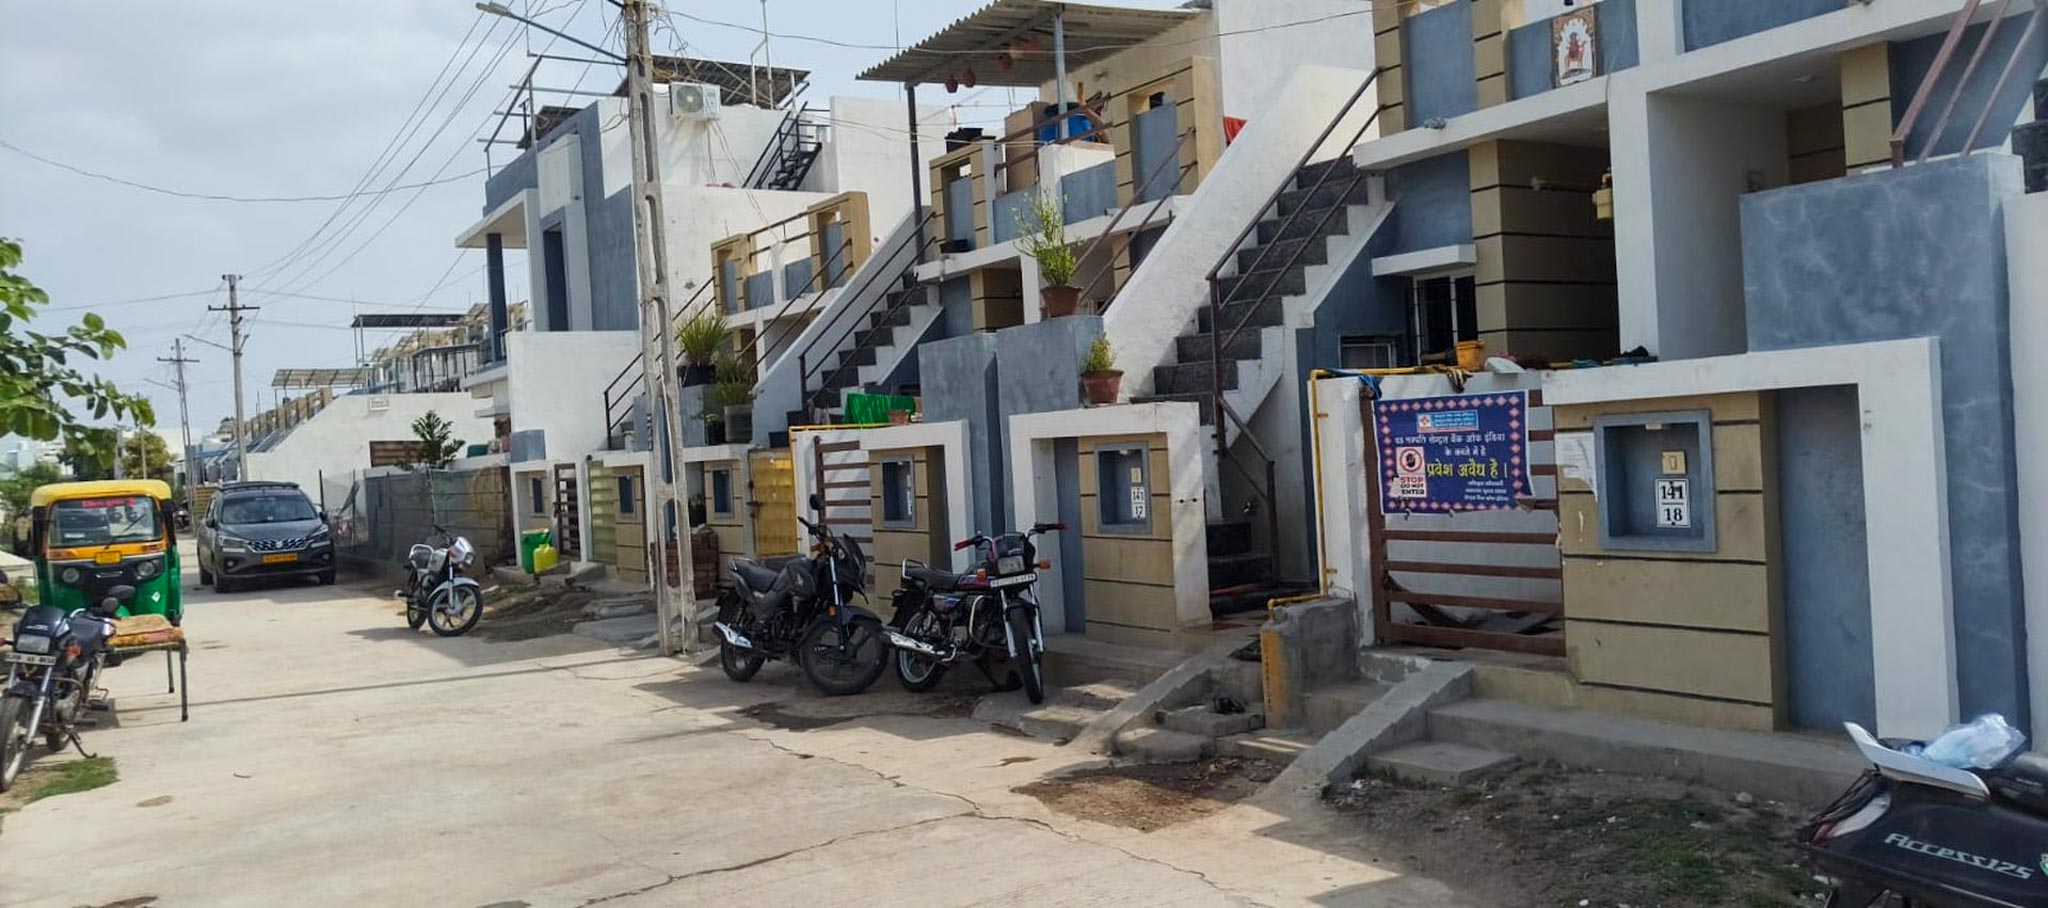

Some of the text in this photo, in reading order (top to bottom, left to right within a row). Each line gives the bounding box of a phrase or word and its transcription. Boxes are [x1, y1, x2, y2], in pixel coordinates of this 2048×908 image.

[1427, 458, 1453, 477] प्रवेश
[1457, 458, 1486, 477] अवैध
[1489, 458, 1498, 478] है
[1661, 485, 1683, 499] 141
[1135, 506, 1143, 515] 17
[1664, 508, 1683, 522] 18
